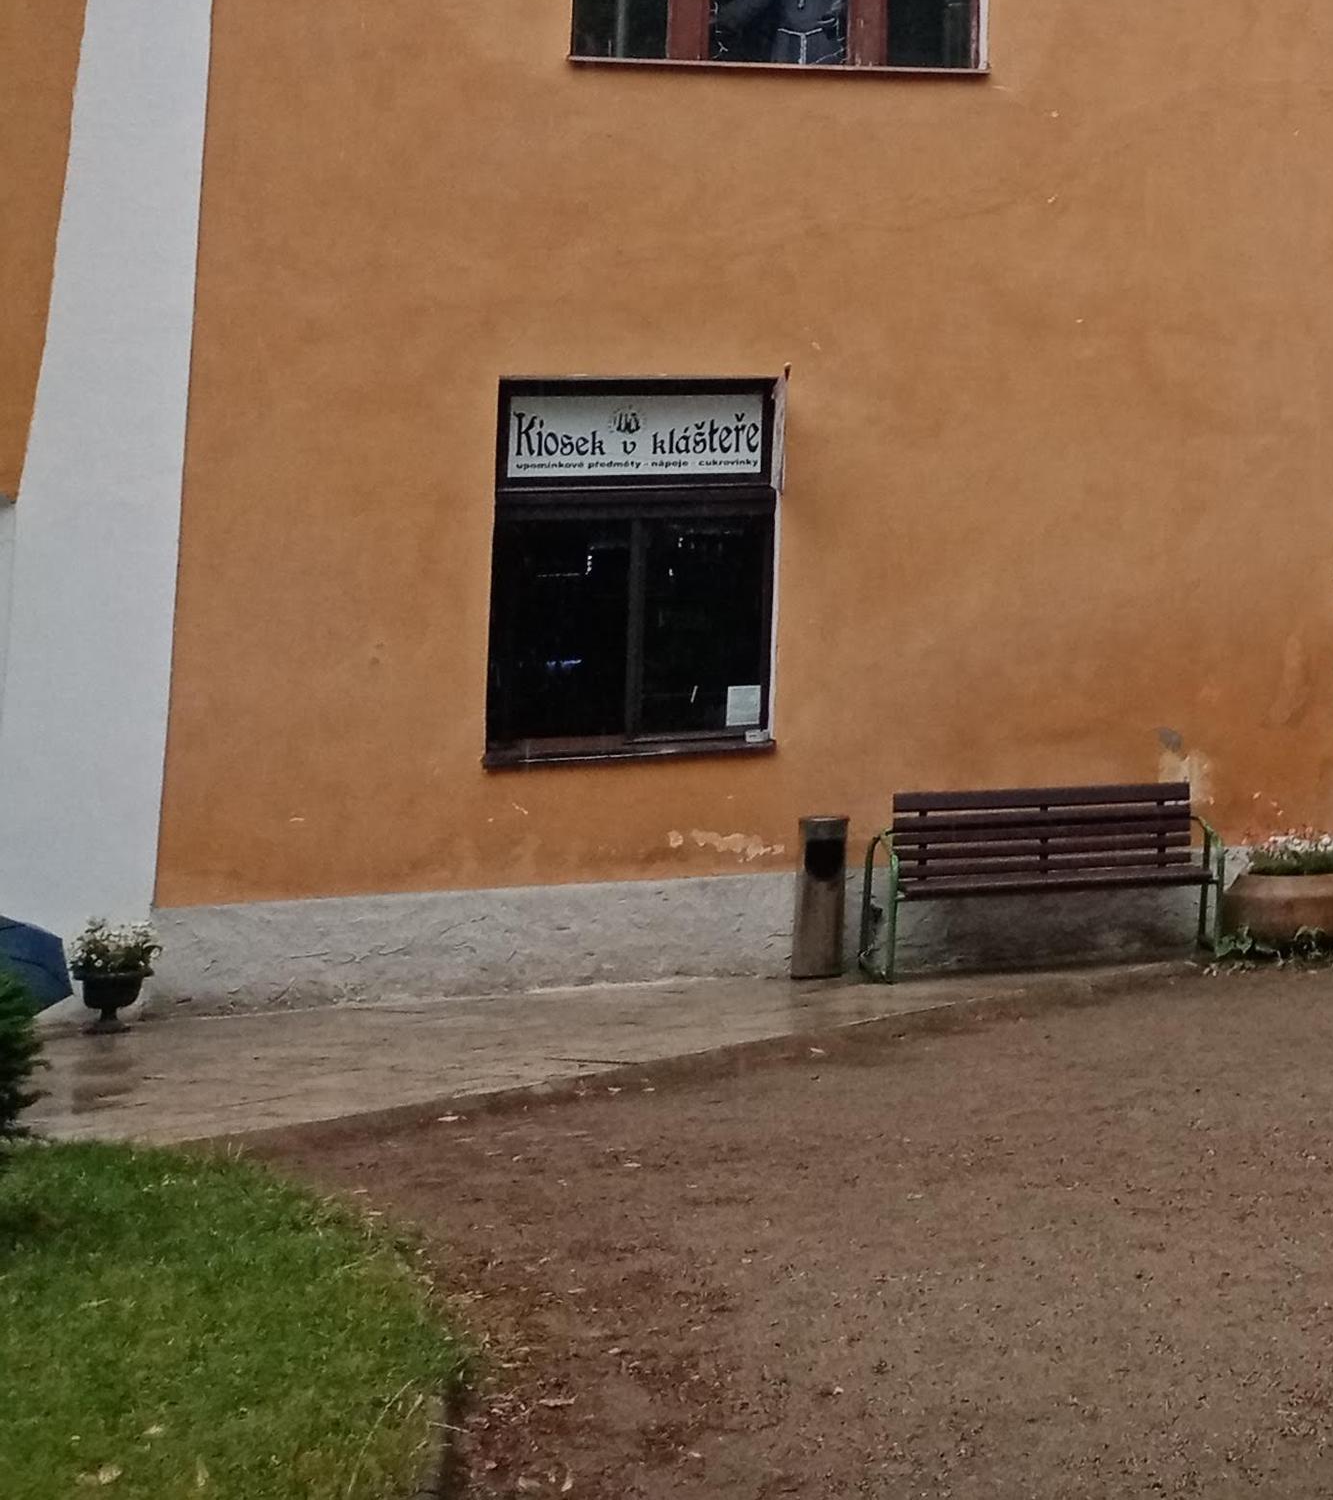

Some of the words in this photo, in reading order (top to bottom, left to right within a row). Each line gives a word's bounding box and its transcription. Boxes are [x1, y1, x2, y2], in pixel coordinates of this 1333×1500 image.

[513, 411, 605, 456] Kiosek
[622, 440, 637, 455] v
[652, 412, 759, 455] klášteře
[698, 457, 758, 467] cukrovinky
